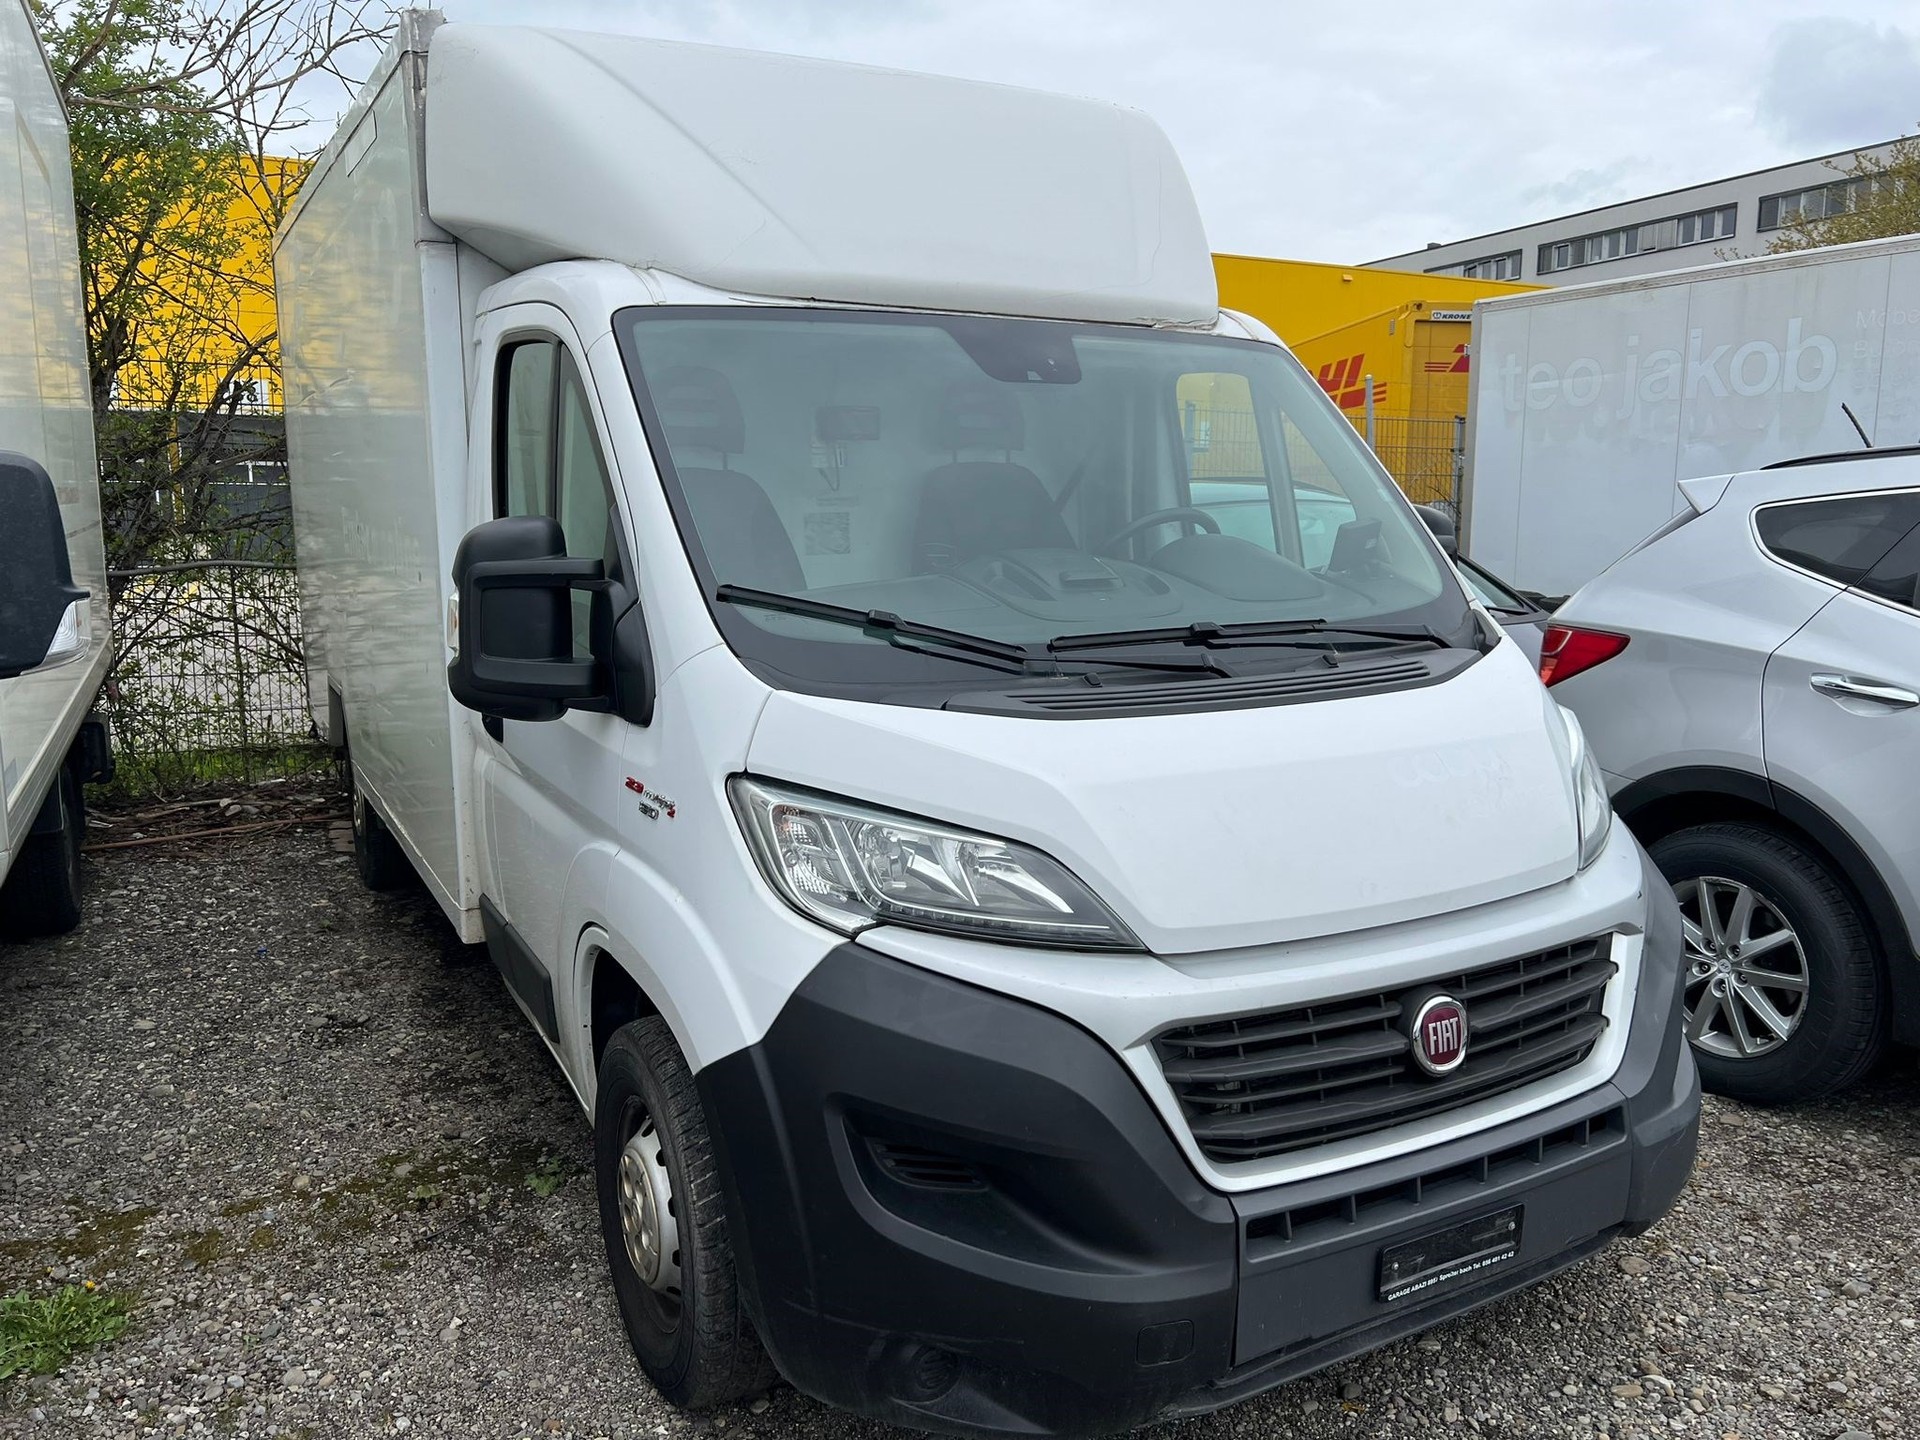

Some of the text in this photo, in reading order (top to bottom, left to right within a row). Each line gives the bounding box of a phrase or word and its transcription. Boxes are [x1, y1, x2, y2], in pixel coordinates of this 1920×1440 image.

[1500, 316, 1840, 421] teo jakob
[1427, 1016, 1459, 1056] FIAT
[1388, 1287, 1411, 1301] GARAGE
